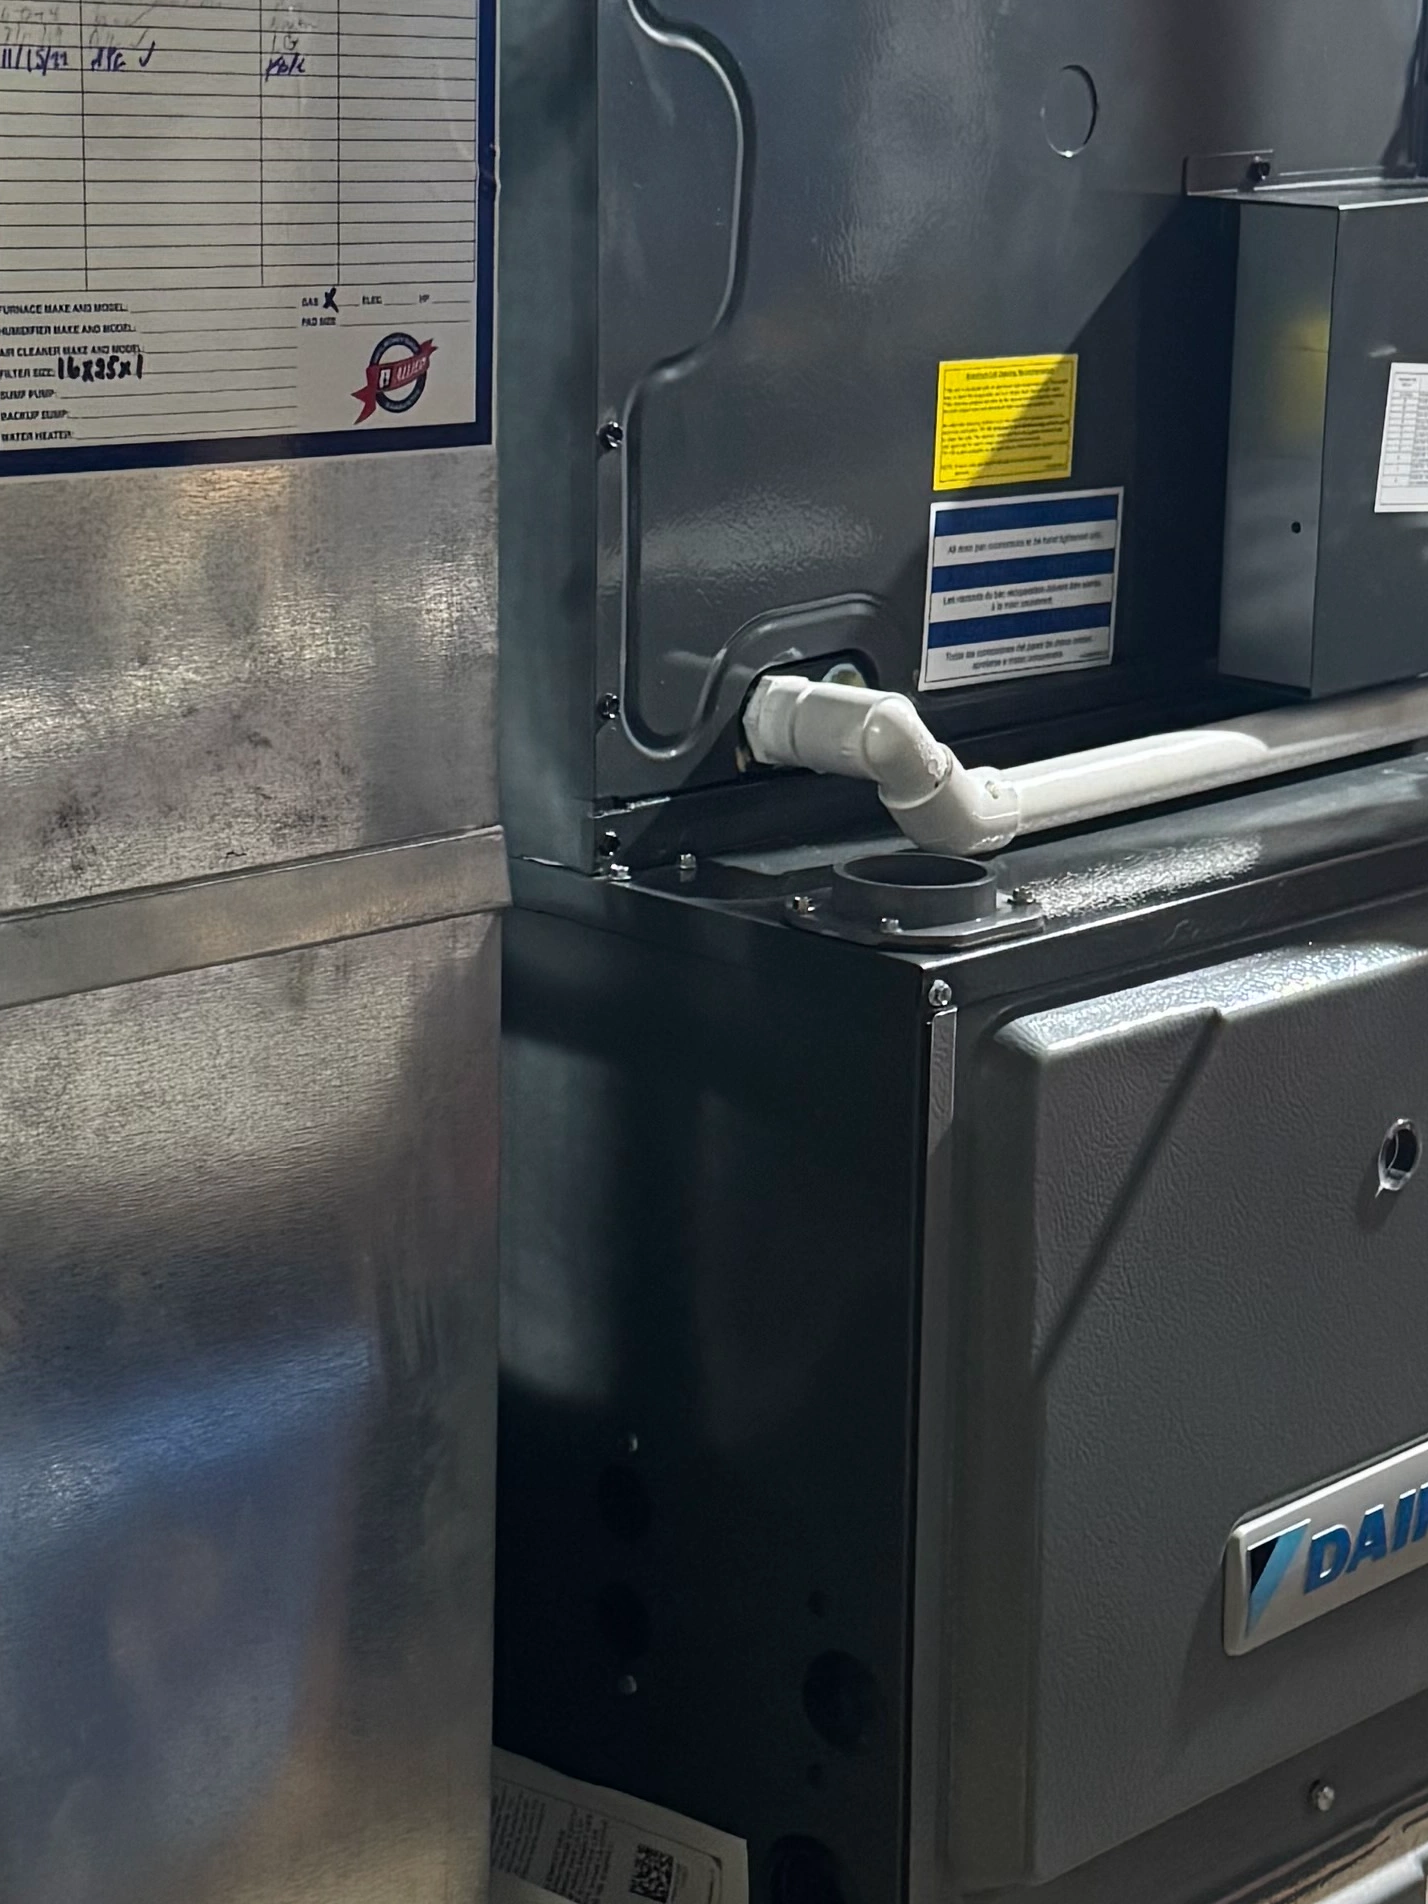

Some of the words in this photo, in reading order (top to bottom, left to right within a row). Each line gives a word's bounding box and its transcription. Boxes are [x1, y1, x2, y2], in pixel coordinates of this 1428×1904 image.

[44, 304, 70, 313] MAKE
[72, 303, 92, 313] AND
[81, 324, 101, 334] AND
[17, 346, 61, 356] CLEANER
[0, 369, 30, 379] FILTER
[1, 432, 33, 442] WATER
